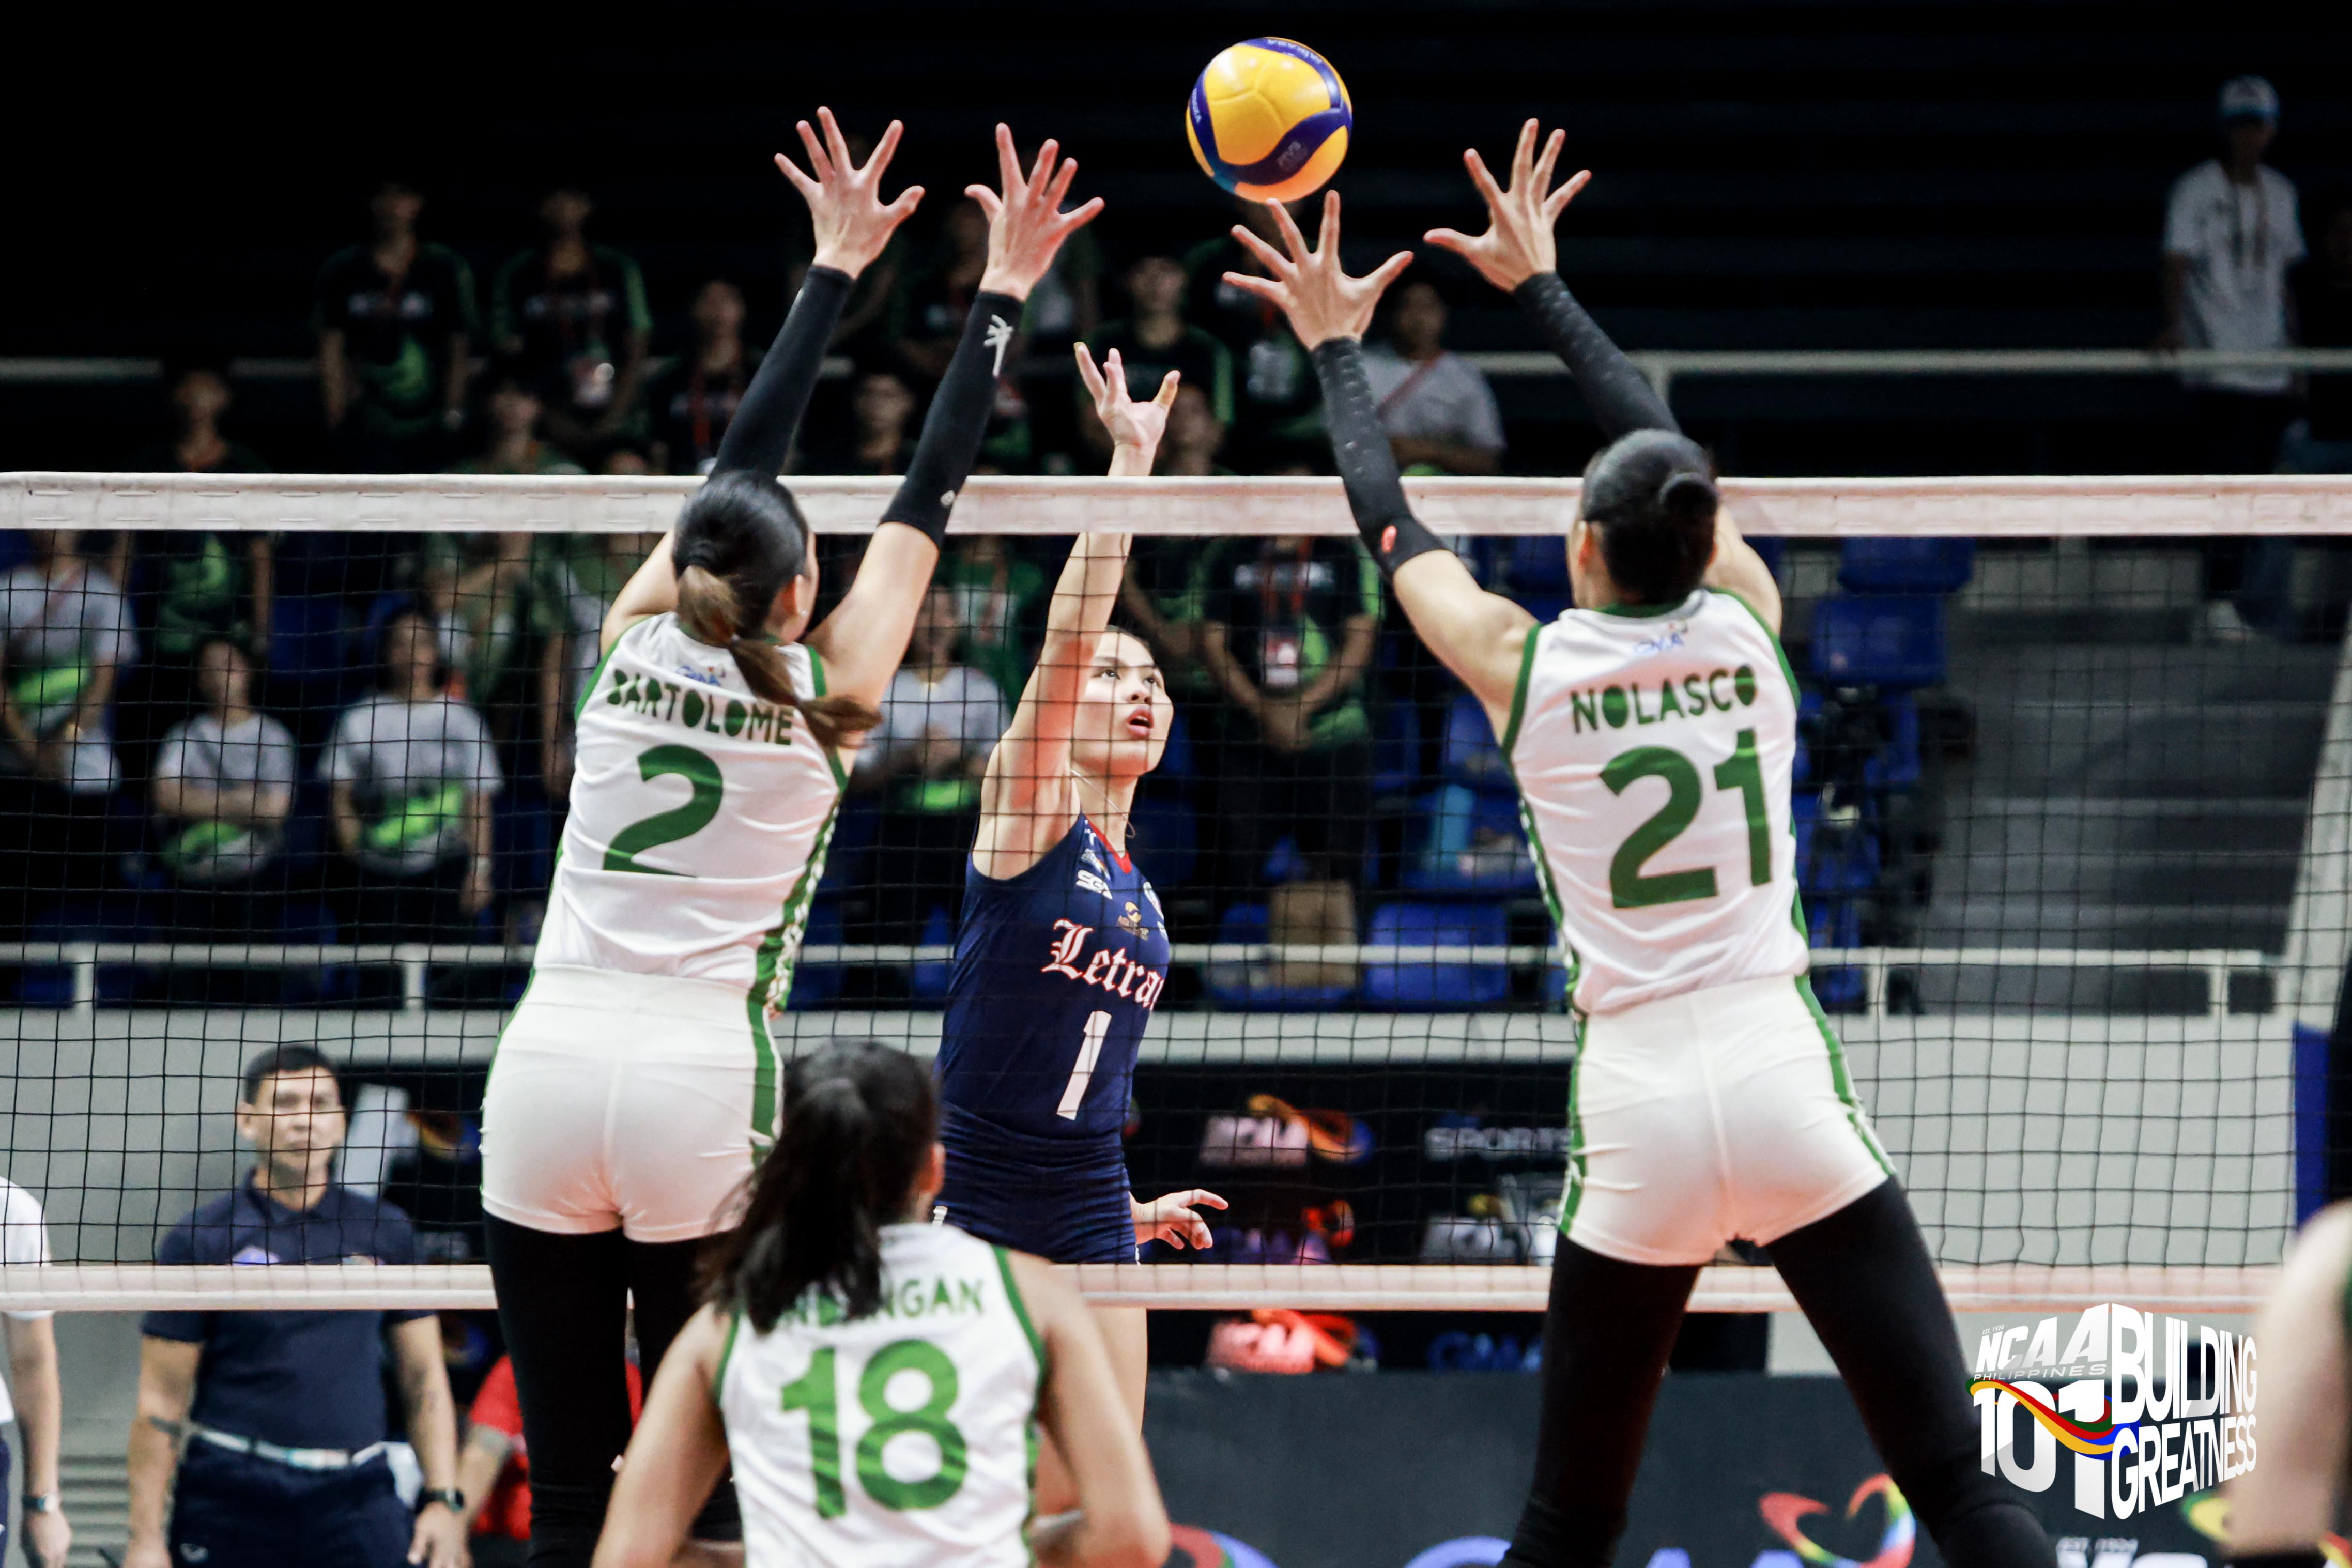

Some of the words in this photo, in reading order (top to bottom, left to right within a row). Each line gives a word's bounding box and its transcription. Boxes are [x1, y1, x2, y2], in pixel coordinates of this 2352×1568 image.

[607, 668, 793, 745] BARTOLOME
[1571, 663, 1756, 734] NOLASCO
[602, 743, 723, 878] 2
[1599, 728, 1772, 908] 21
[1055, 1010, 1112, 1120] 1
[781, 1338, 967, 1520] 18
